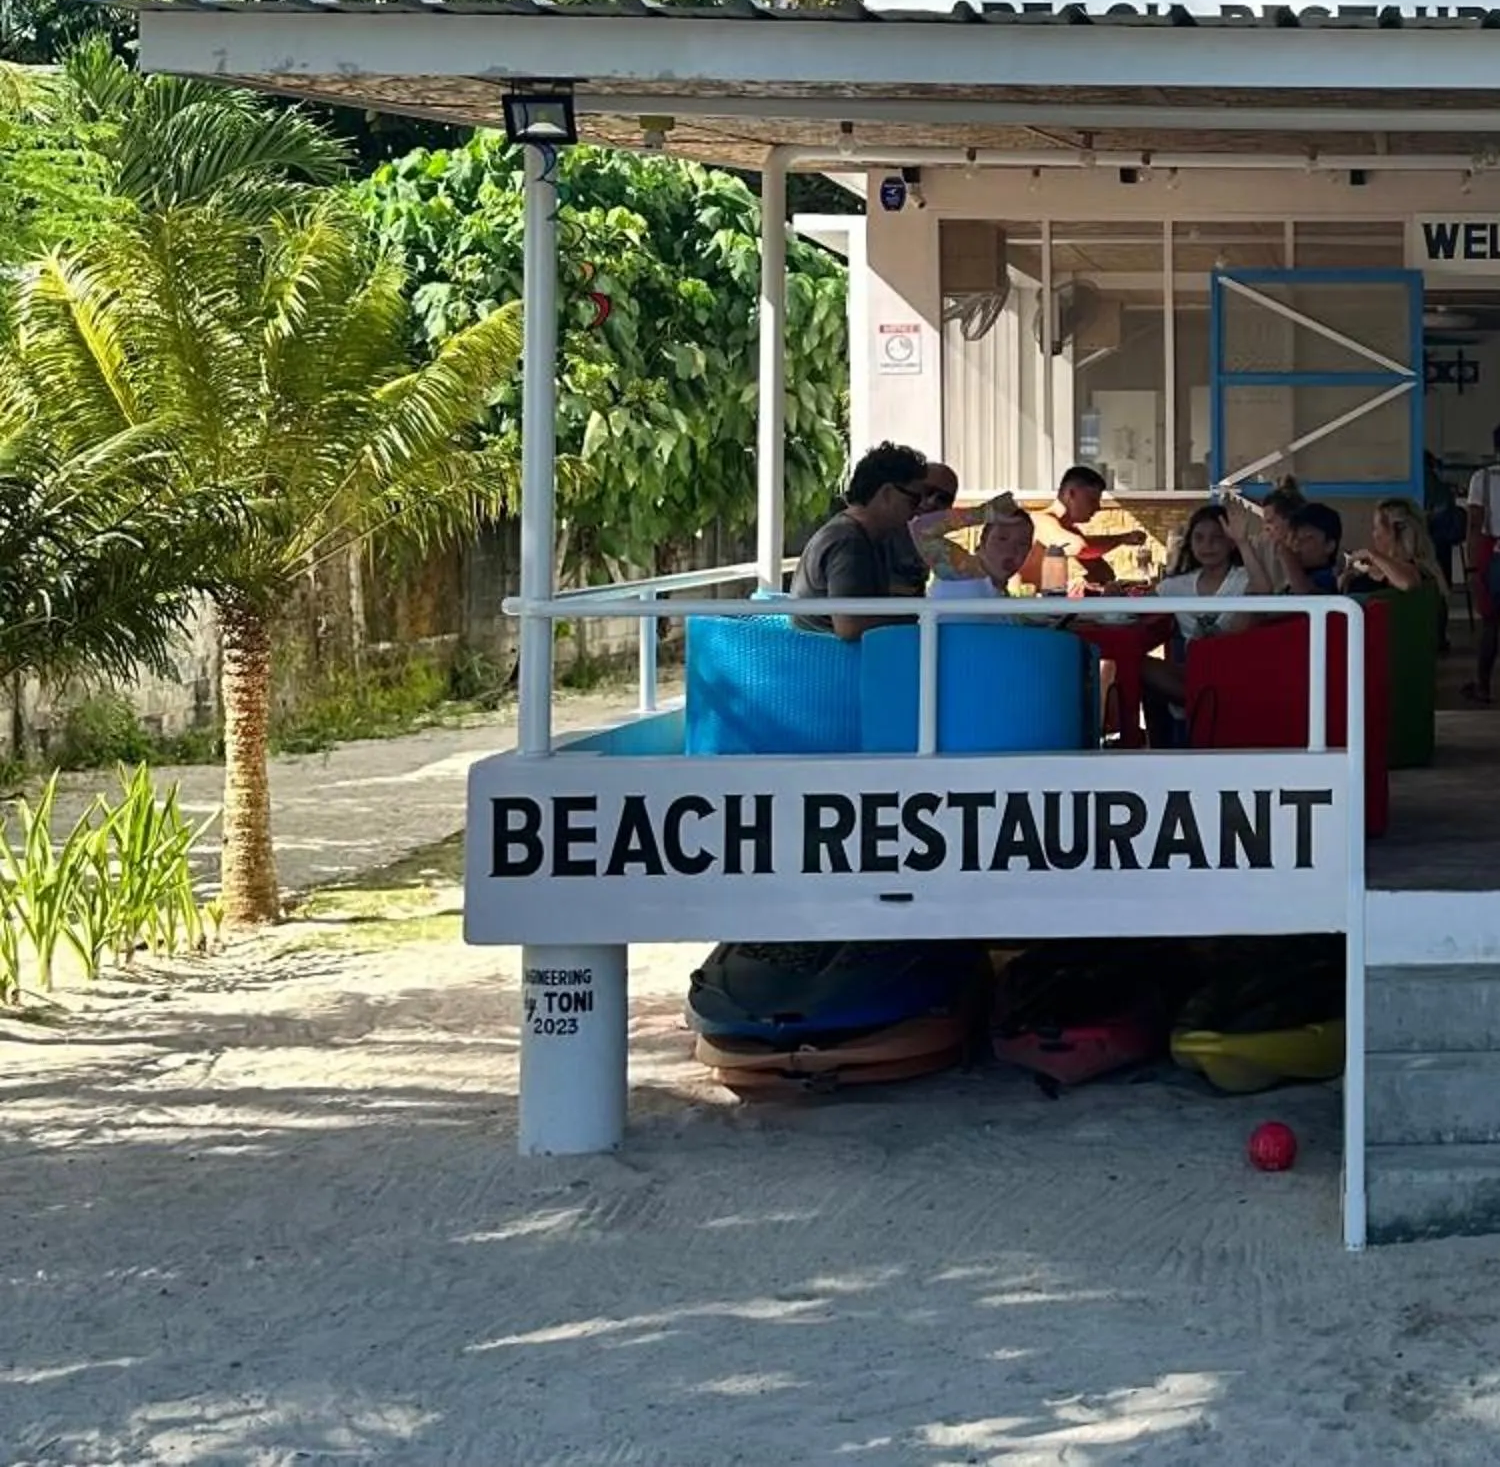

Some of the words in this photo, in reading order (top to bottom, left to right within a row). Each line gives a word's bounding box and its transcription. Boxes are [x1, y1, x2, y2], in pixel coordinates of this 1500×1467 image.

[489, 795, 775, 879] BEACH
[801, 789, 1334, 873] RESTAURANT
[544, 991, 593, 1013] TONI
[534, 1018, 578, 1035] 2023
